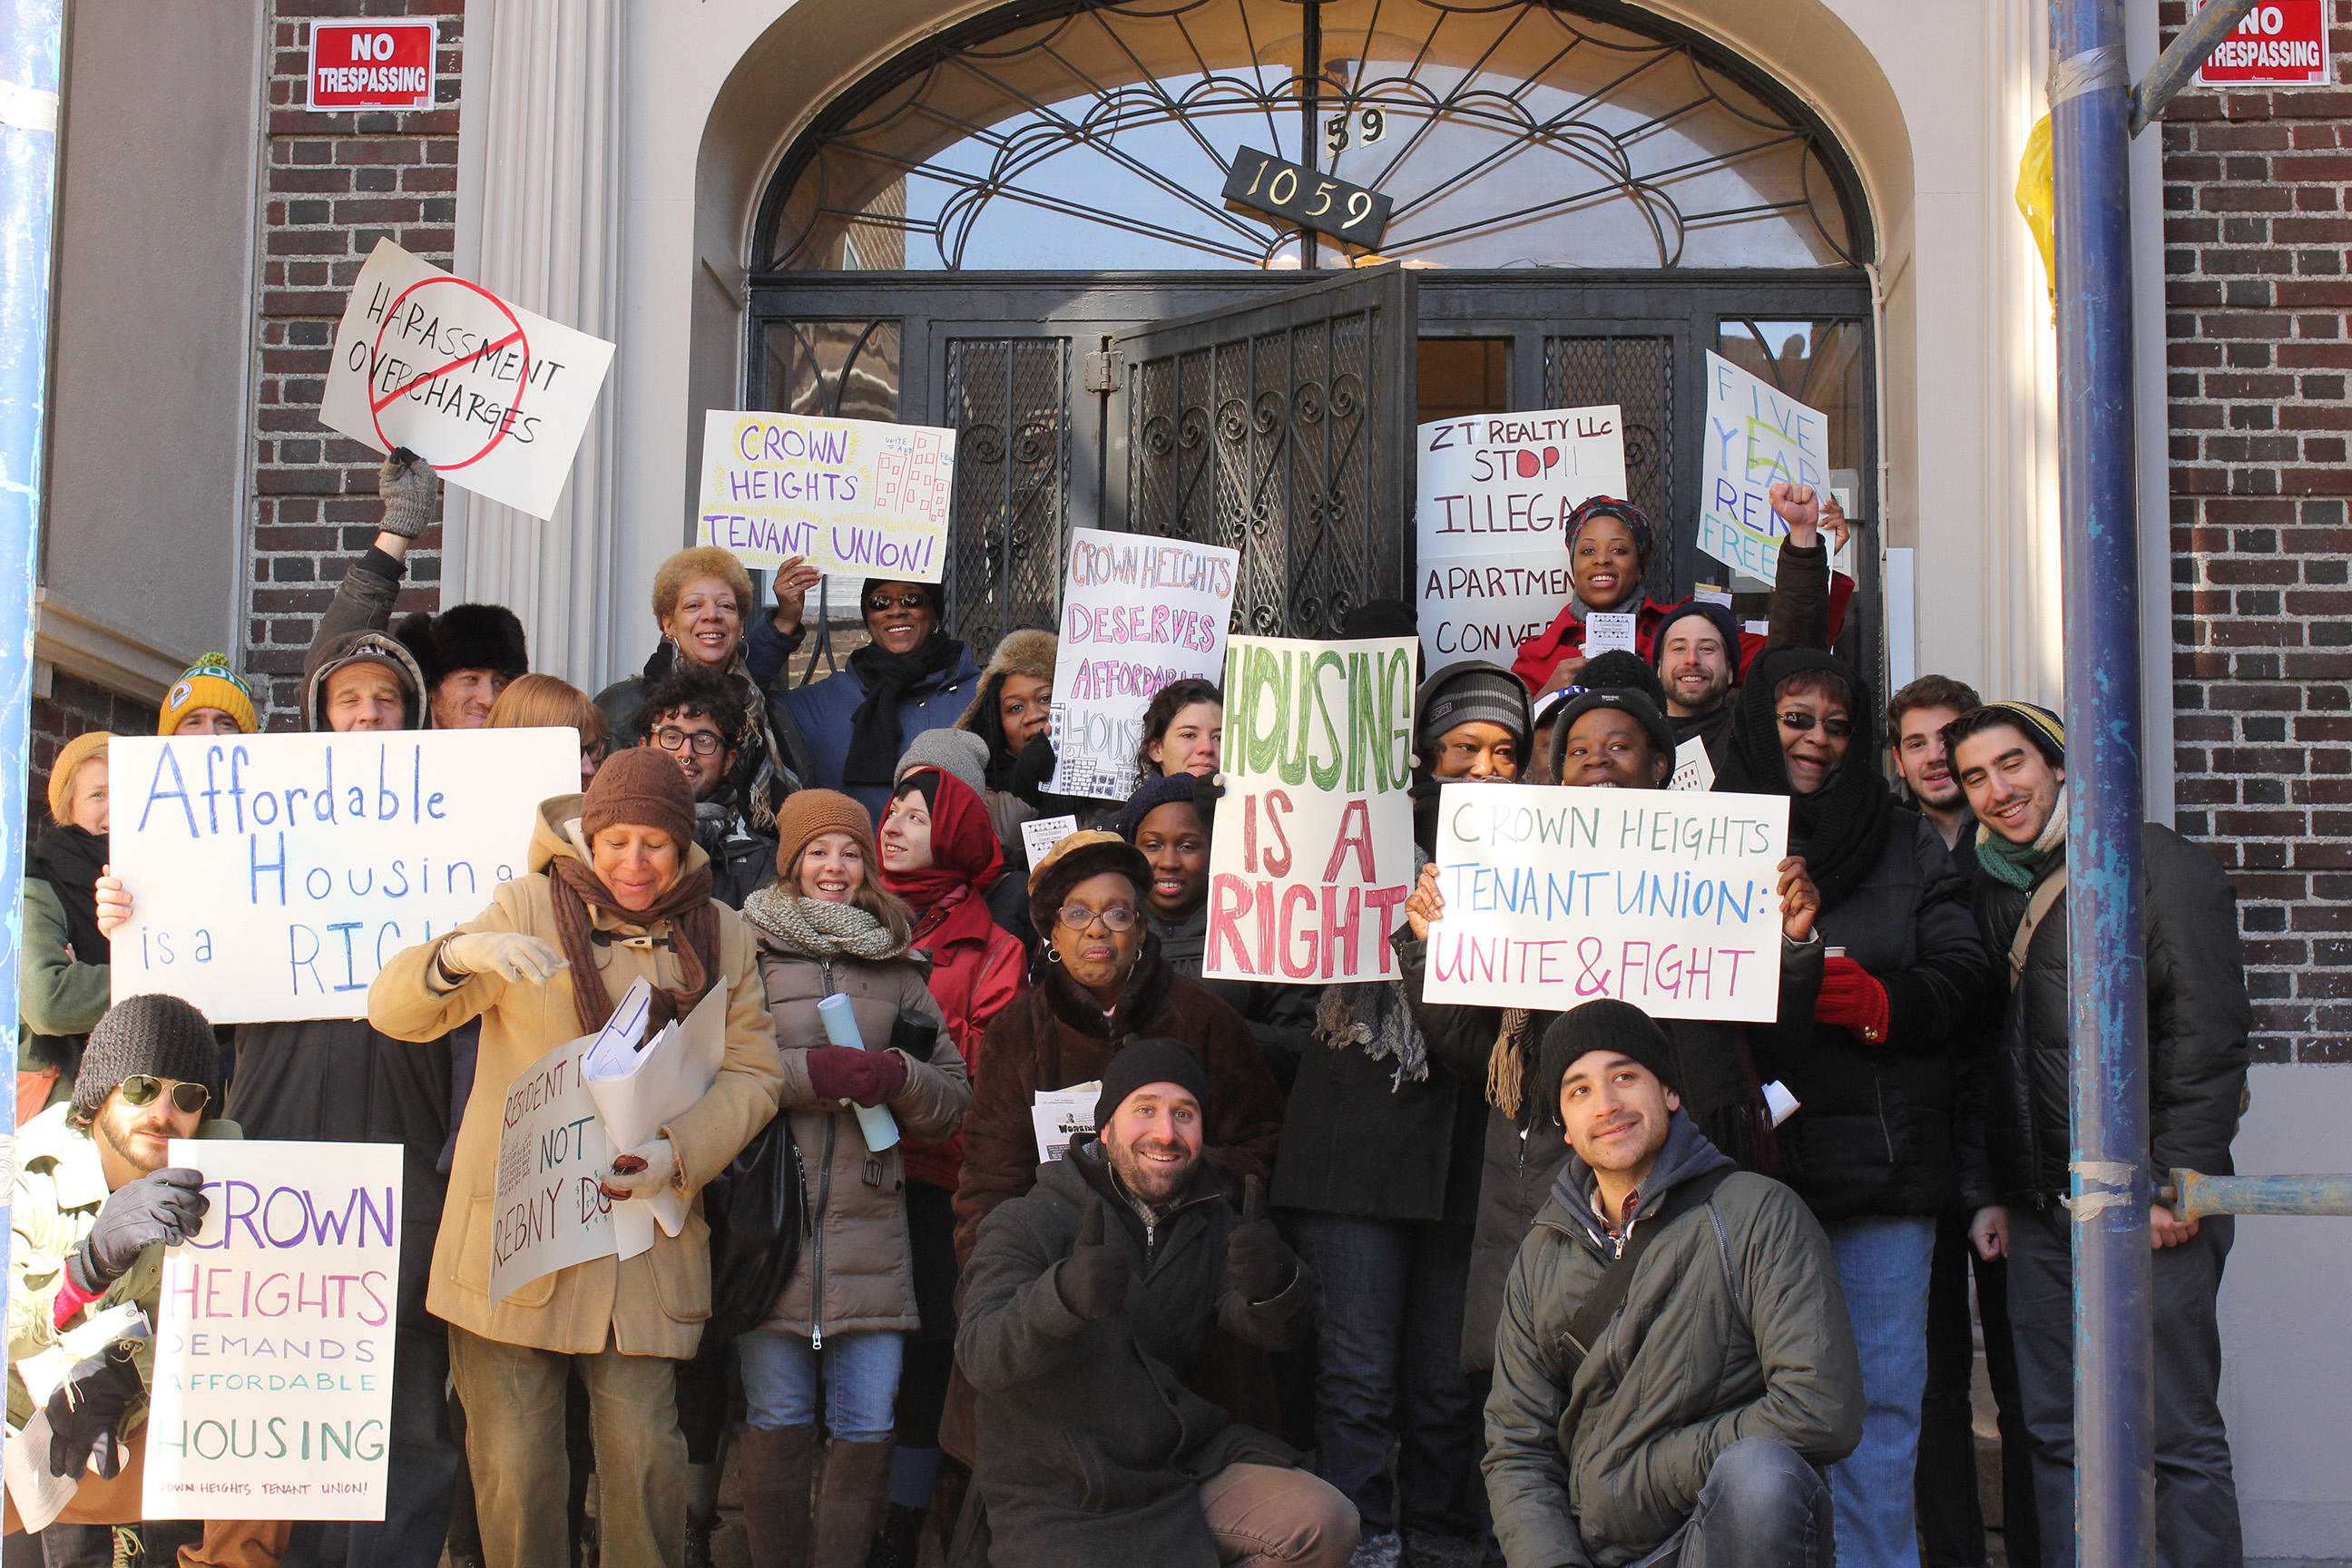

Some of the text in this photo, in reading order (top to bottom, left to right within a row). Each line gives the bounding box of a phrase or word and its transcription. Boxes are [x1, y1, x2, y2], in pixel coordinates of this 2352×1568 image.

[350, 33, 395, 62] NO
[2238, 6, 2284, 34] NO
[318, 65, 426, 93] TRESPASSING
[1246, 159, 1373, 230] 1059
[367, 281, 566, 391] HARASSMENT
[348, 339, 542, 444] OVERCHARGES
[1718, 364, 1817, 458] FIVE
[740, 425, 848, 466] CROWN
[1429, 421, 1482, 452] ZT
[1489, 417, 1570, 444] REALTY
[1712, 416, 1827, 507] YEAR
[730, 470, 859, 502] HEIGHTS
[1434, 495, 1591, 534] ILLEGA
[1715, 477, 1791, 537] REN
[703, 515, 935, 575] TENANT UNION!
[1072, 539, 1231, 600] CROWN HEIGHTS
[1425, 566, 1575, 600] APARTMEN
[1068, 603, 1216, 653] DESERVES
[1436, 620, 1554, 654] CONVE
[1222, 643, 1411, 795] HOUSING
[137, 742, 447, 838] Affordable
[1243, 788, 1377, 884] IS A
[1452, 802, 1770, 861] CROWN HEIGHTS
[1444, 862, 1611, 922] TENANT
[141, 926, 175, 970] is
[194, 928, 213, 965] a
[1206, 873, 1408, 979] RIGHT
[1435, 931, 1756, 1000] UNITE & FIGHT
[501, 1059, 568, 1140] RESIDENT
[539, 1115, 595, 1174] NOT
[492, 1177, 564, 1279] REBNY
[170, 1262, 388, 1327] HEIGHTS
[157, 1416, 385, 1462] HOUSING
[200, 1483, 251, 1496] HEIGHTS
[261, 1483, 312, 1495] TENANT
[321, 1482, 369, 1495] UNION!
